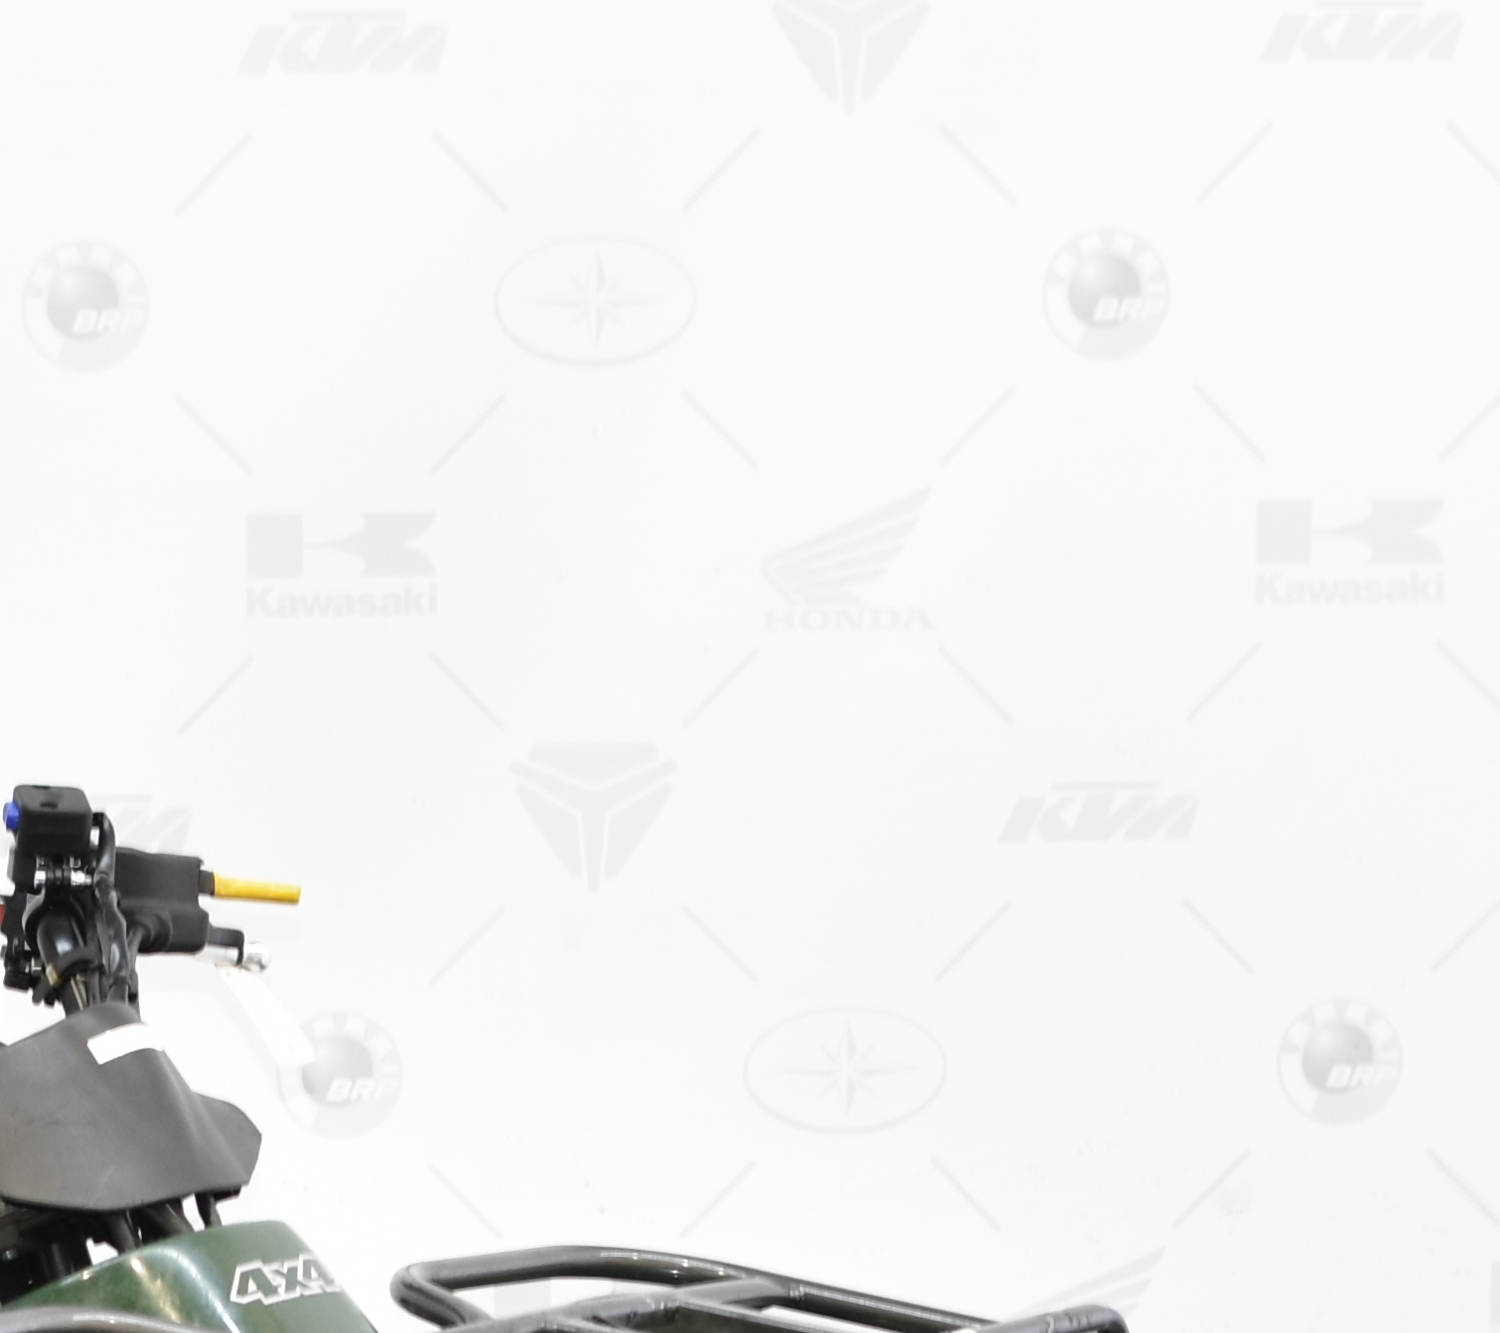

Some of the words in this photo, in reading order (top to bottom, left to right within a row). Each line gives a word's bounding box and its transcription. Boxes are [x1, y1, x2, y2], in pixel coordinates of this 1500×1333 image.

[238, 10, 449, 75] KTM
[1260, 0, 1464, 63] KTM
[72, 309, 145, 334] BRP
[1093, 297, 1167, 321] BRP
[246, 583, 438, 618] Kawasaki
[1255, 571, 1445, 604] Kawasaki
[762, 608, 939, 631] HONDA
[997, 780, 1200, 844] KTM
[326, 1076, 399, 1101] BRP
[1326, 1064, 1399, 1089] BRP
